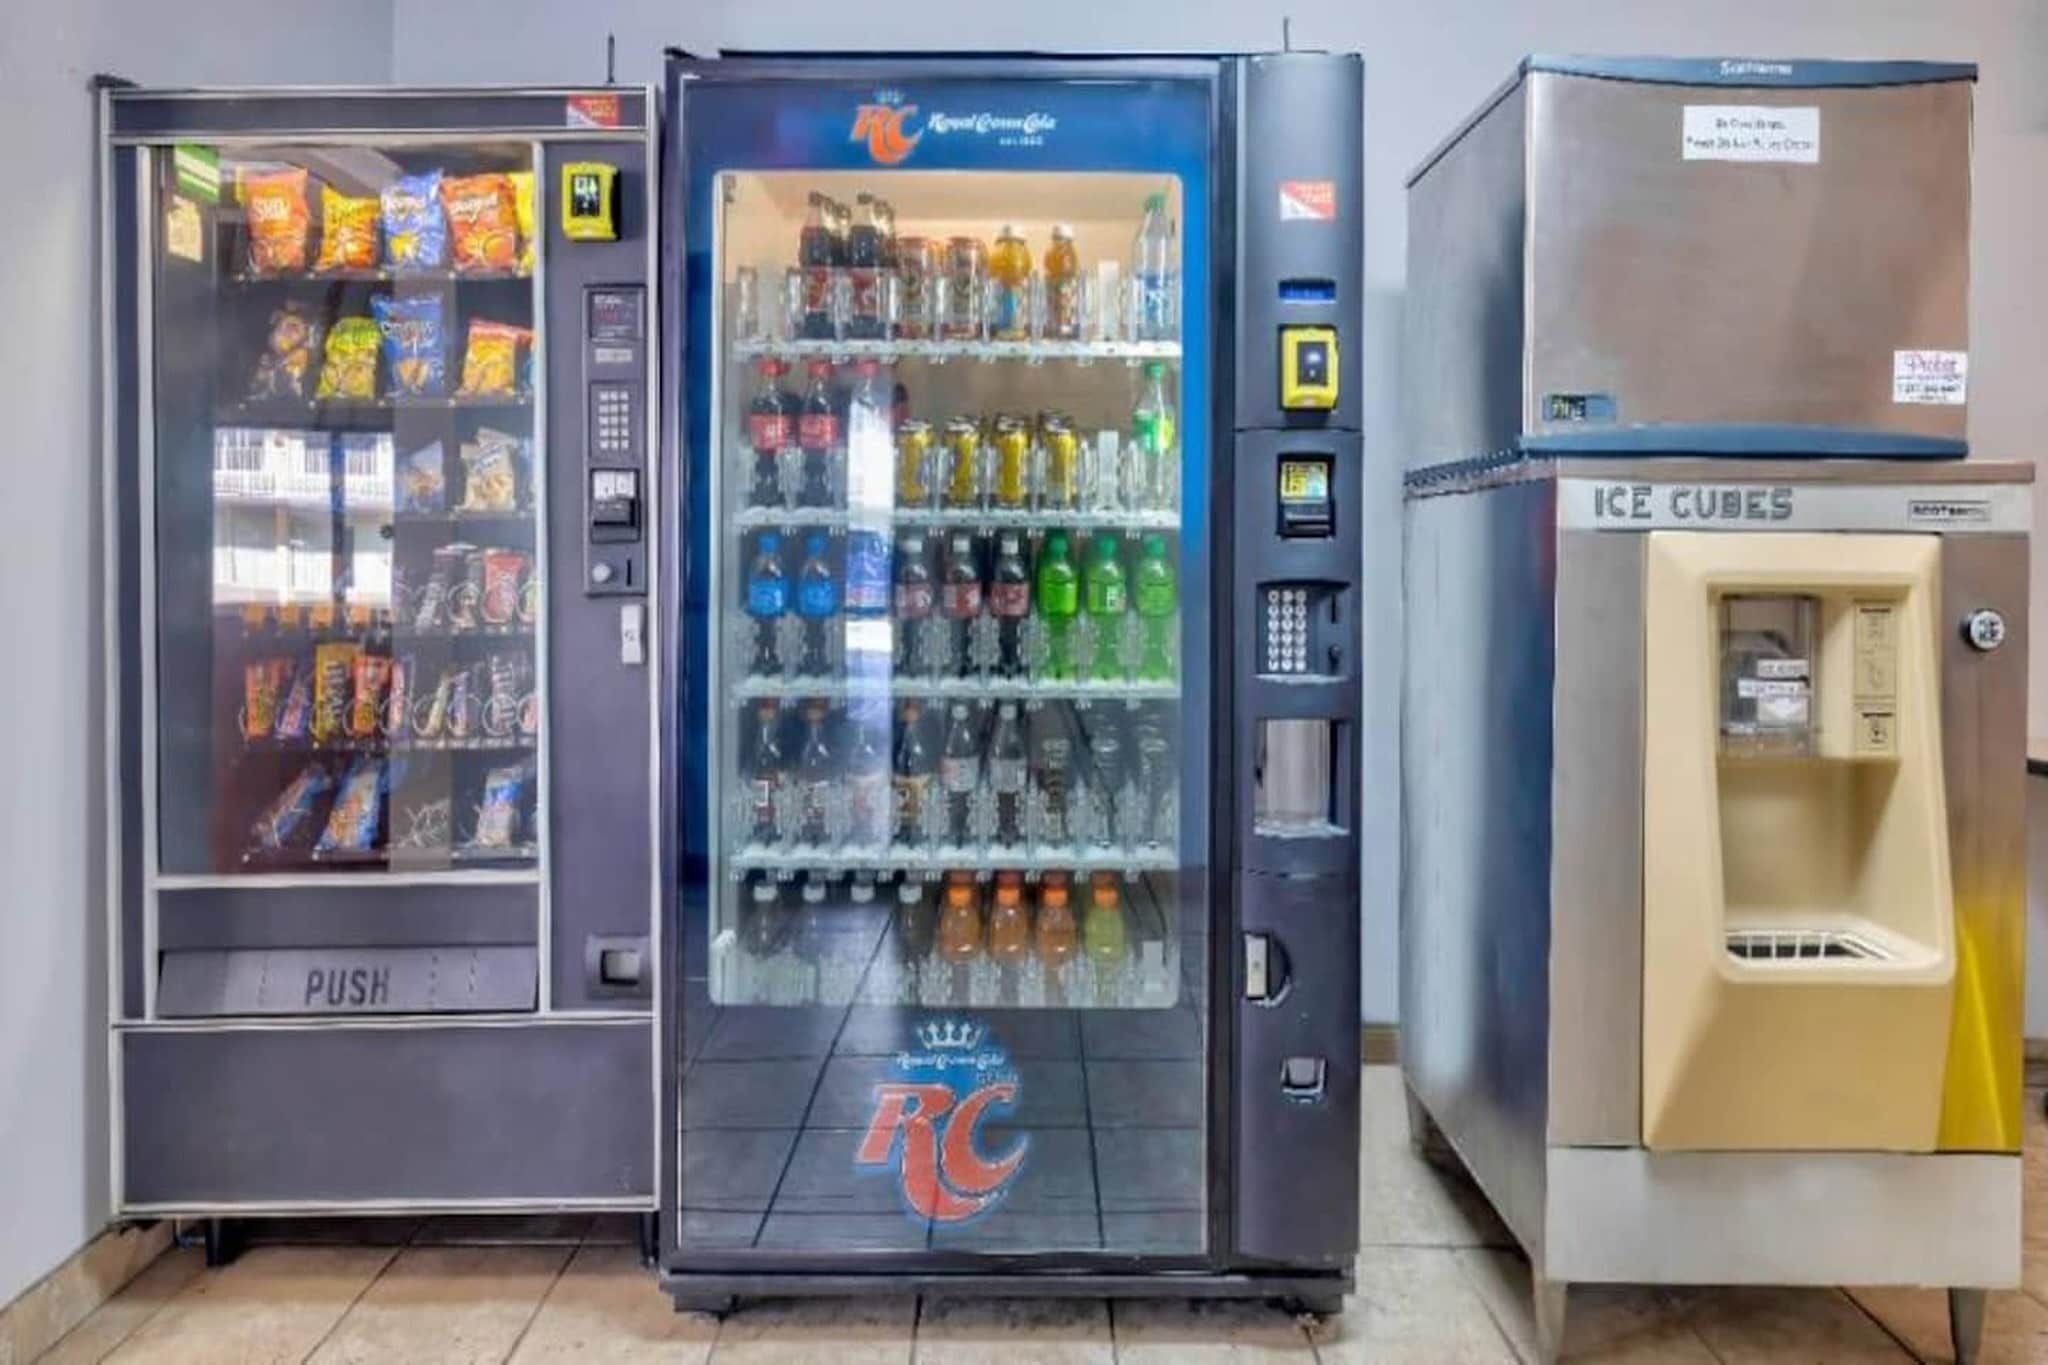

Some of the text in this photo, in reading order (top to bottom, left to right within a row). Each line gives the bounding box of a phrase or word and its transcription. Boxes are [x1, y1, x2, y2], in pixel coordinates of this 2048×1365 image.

[851, 104, 926, 163] RC
[928, 112, 976, 134] Royal
[1023, 112, 1057, 134] Cola
[1595, 486, 1793, 519] ICE CUBES
[304, 967, 391, 1006] PUSH
[855, 1083, 1029, 1222] RC
